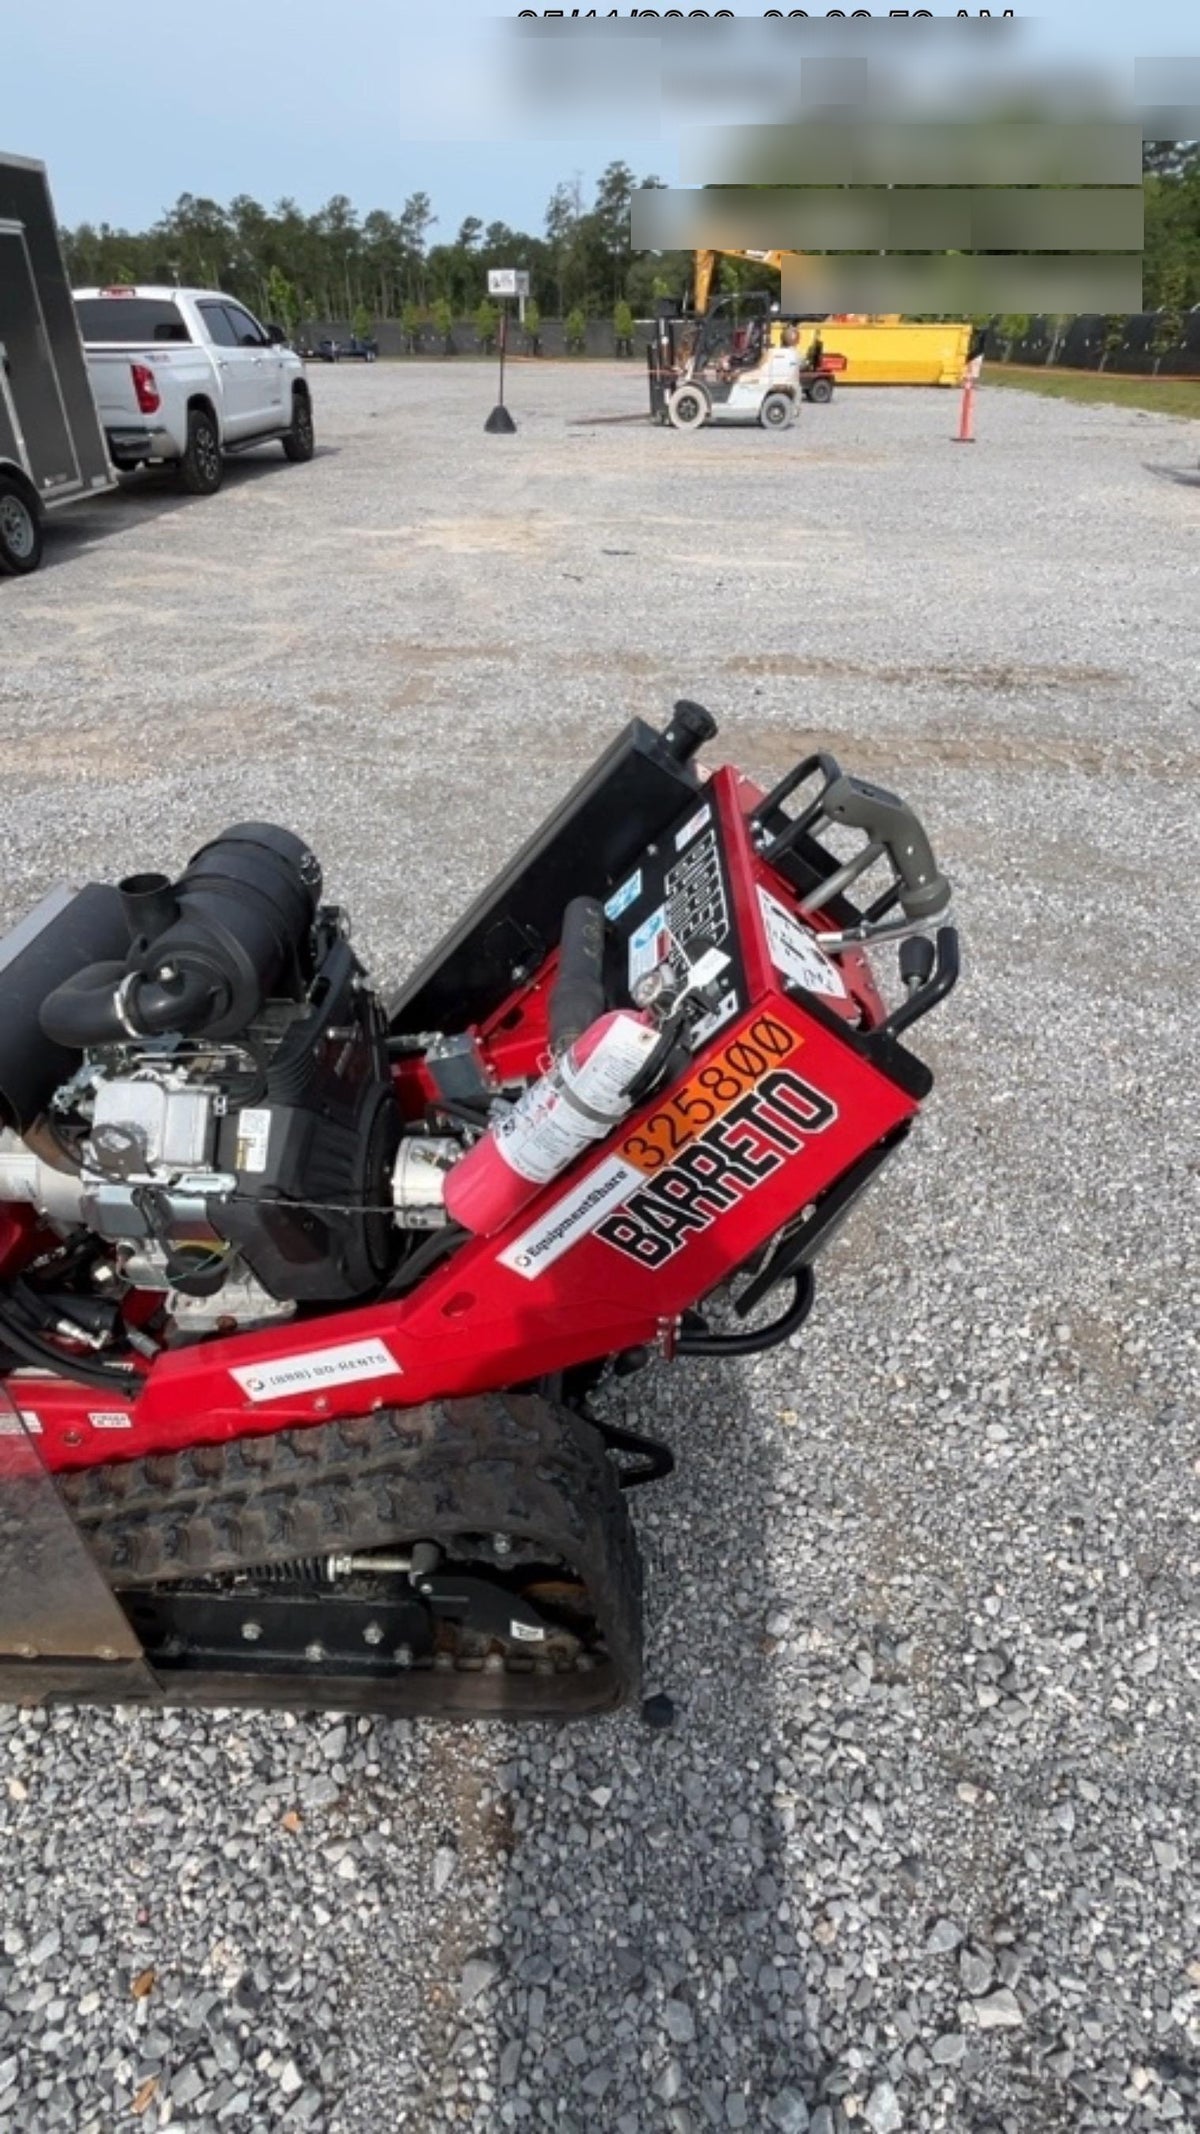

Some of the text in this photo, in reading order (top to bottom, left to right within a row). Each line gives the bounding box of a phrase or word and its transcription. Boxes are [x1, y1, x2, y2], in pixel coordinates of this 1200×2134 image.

[622, 1016, 794, 1168] 325800
[525, 1169, 629, 1257] EquipmentShare
[592, 1068, 838, 1270] BARRETO
